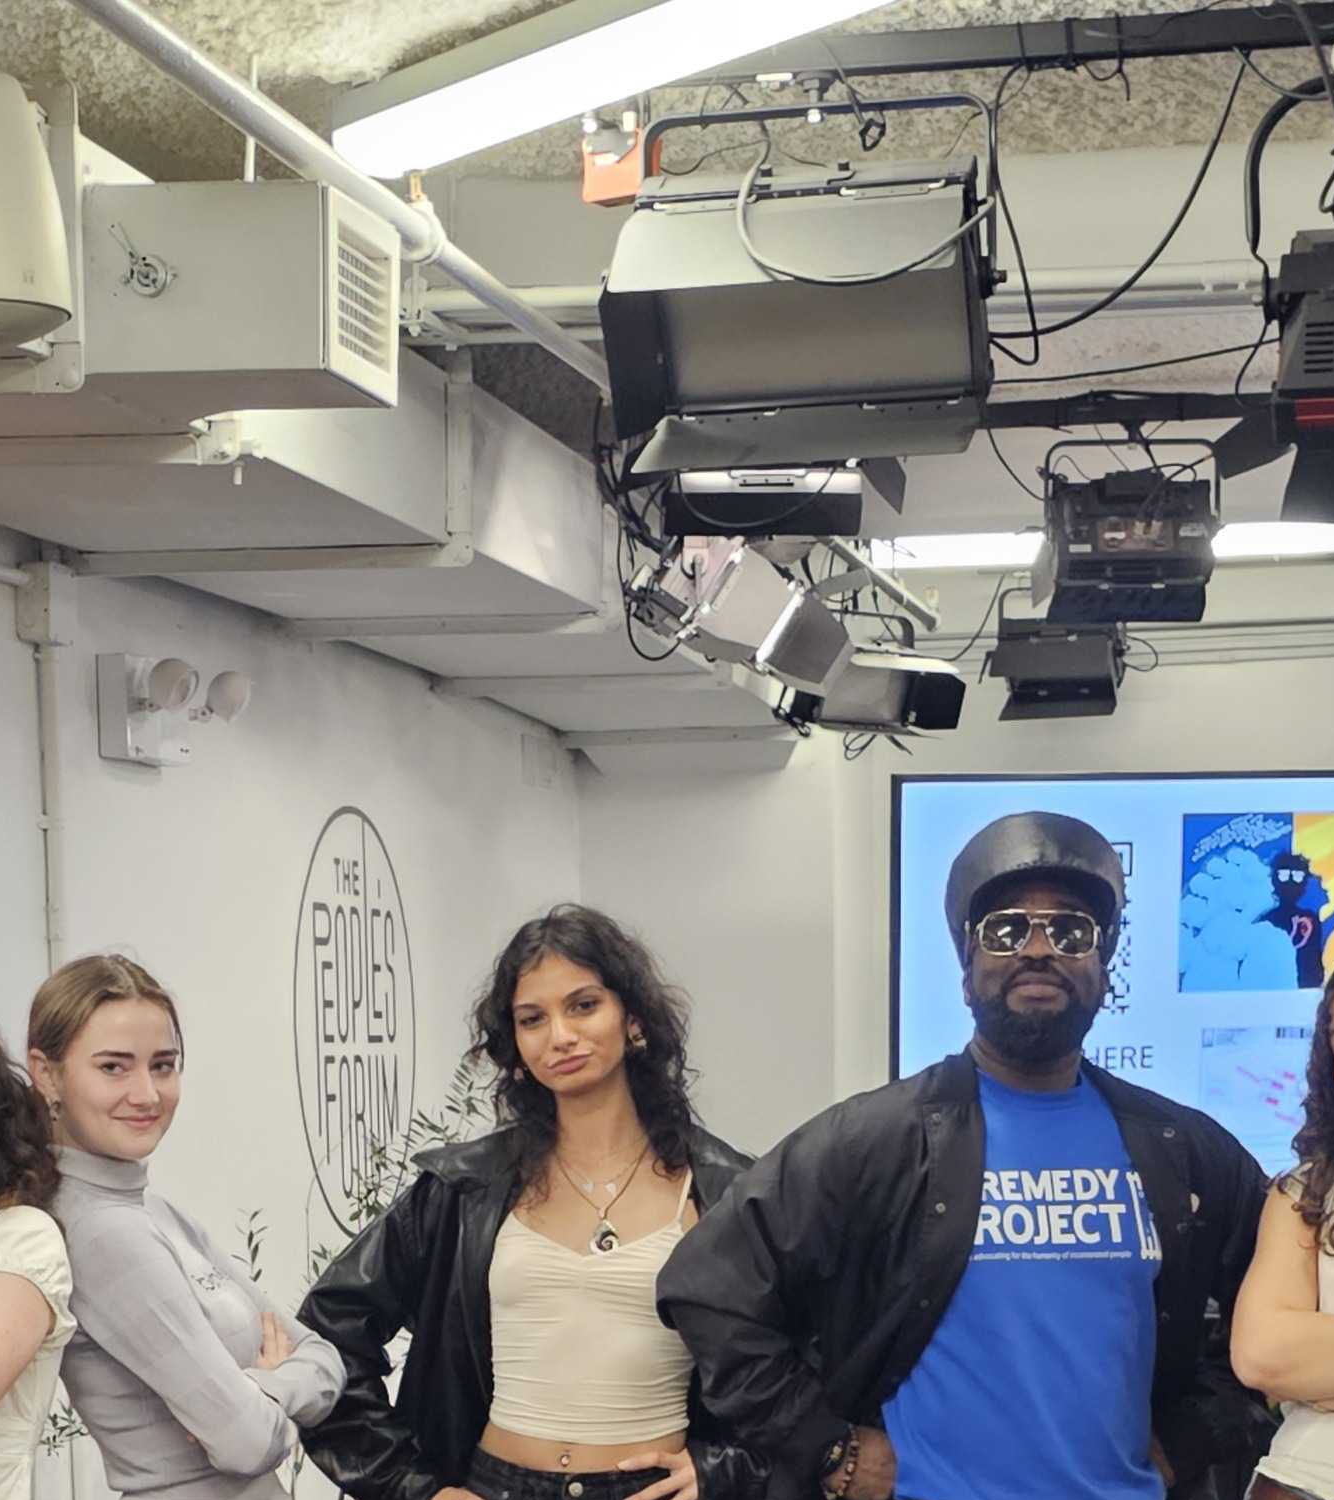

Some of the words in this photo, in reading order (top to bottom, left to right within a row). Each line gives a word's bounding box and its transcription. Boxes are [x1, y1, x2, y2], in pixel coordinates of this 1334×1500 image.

[333, 857, 360, 896] THE
[982, 1168, 1119, 1202] REMEDY
[973, 1203, 1127, 1246] ROJECT
